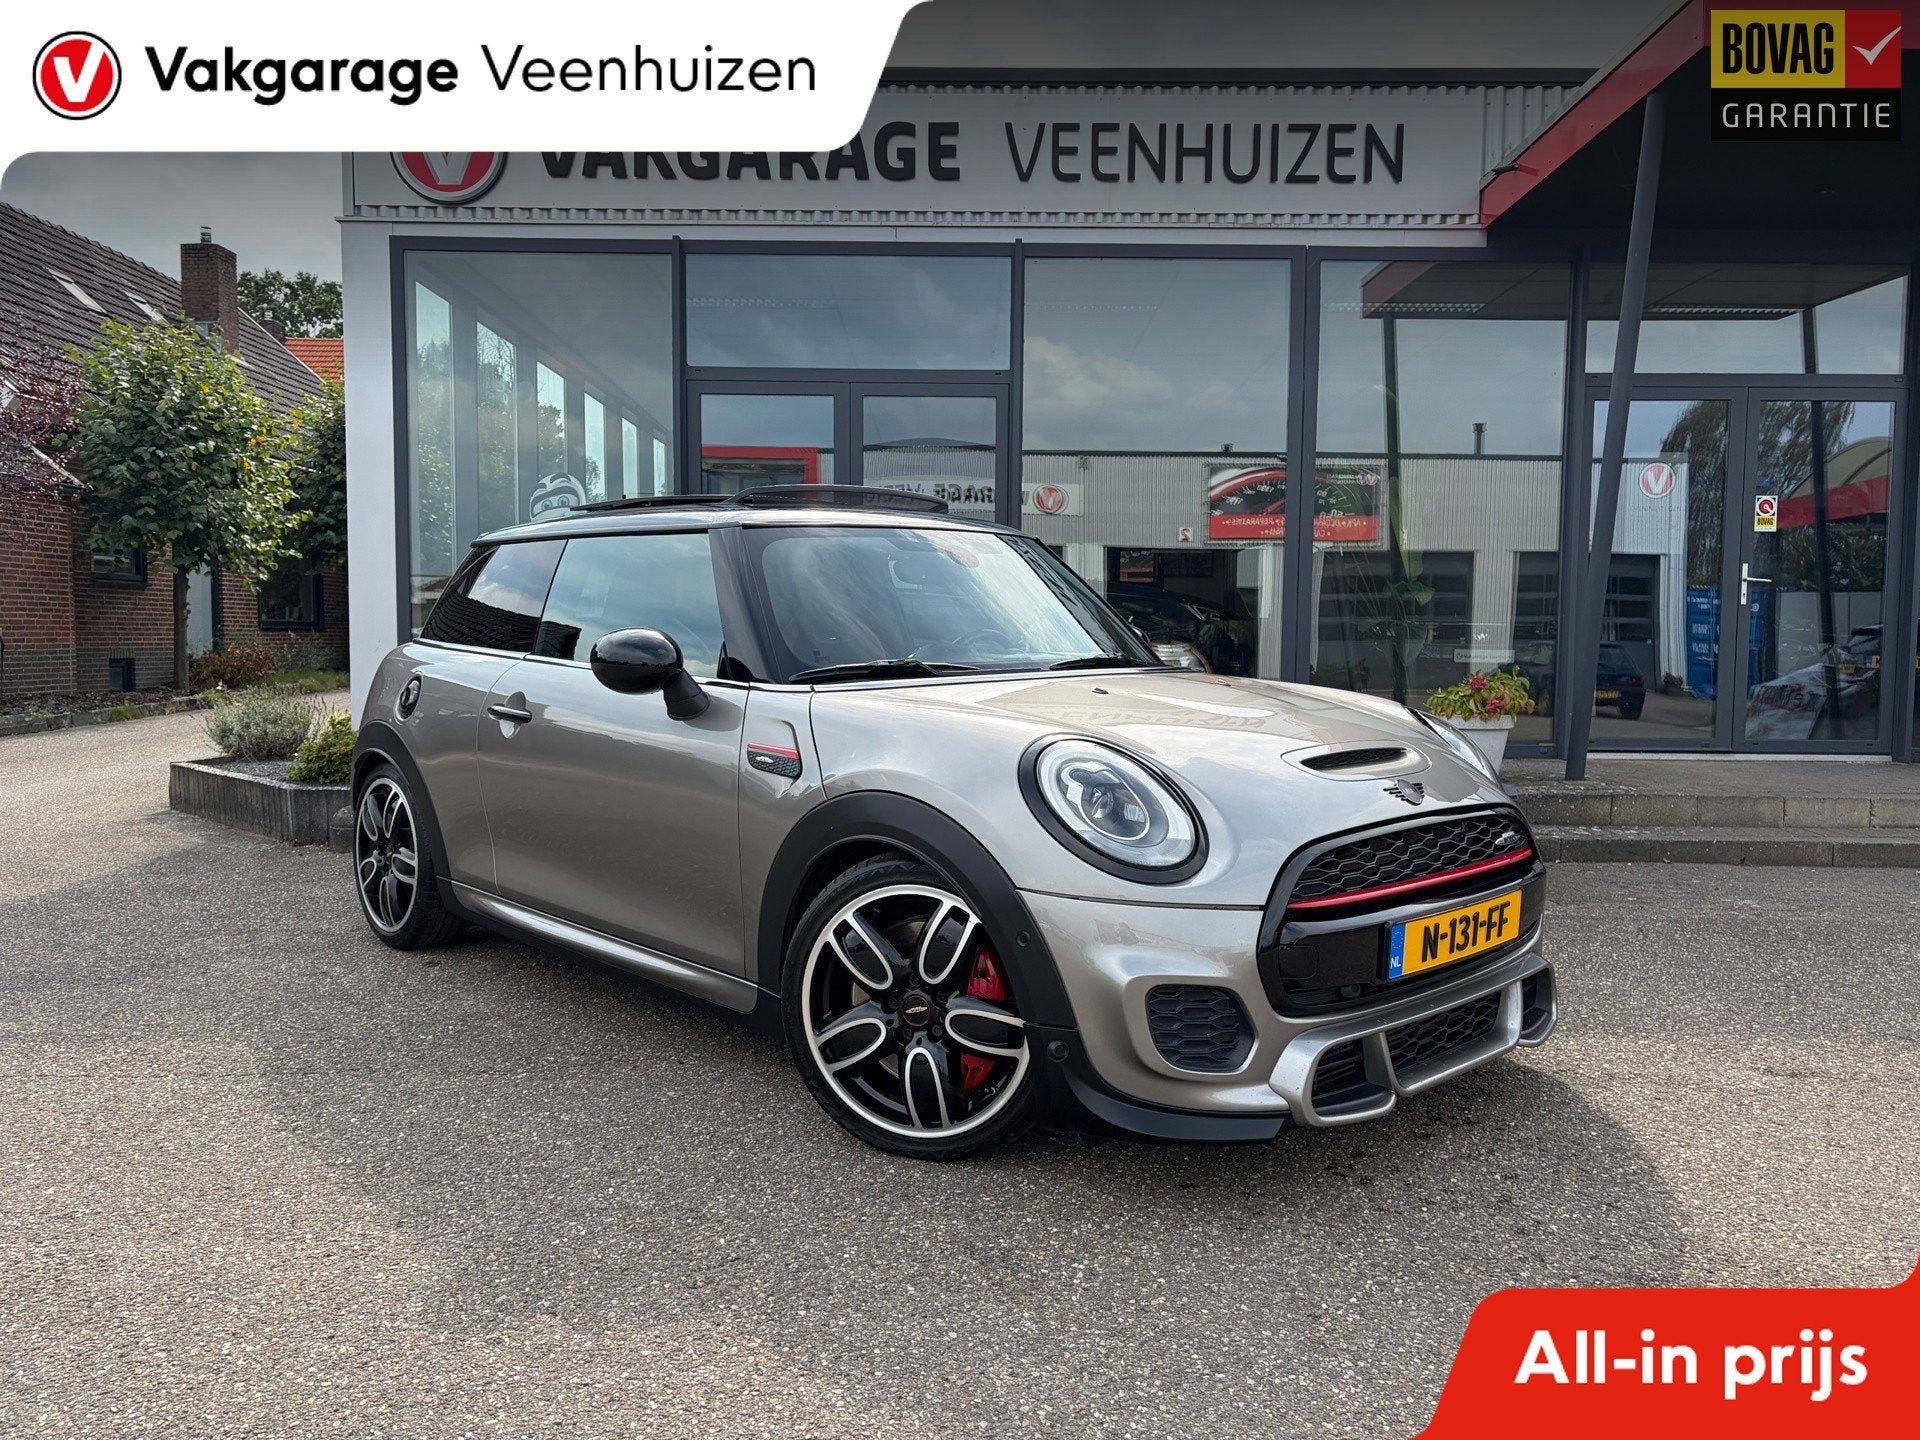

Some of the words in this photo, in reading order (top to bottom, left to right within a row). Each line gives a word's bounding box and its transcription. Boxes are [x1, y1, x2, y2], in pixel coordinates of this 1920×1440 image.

[1005, 122, 1405, 184] VEENHUIZEN
[1390, 955, 1401, 969] NL
[1421, 900, 1511, 963] N-131-FF
